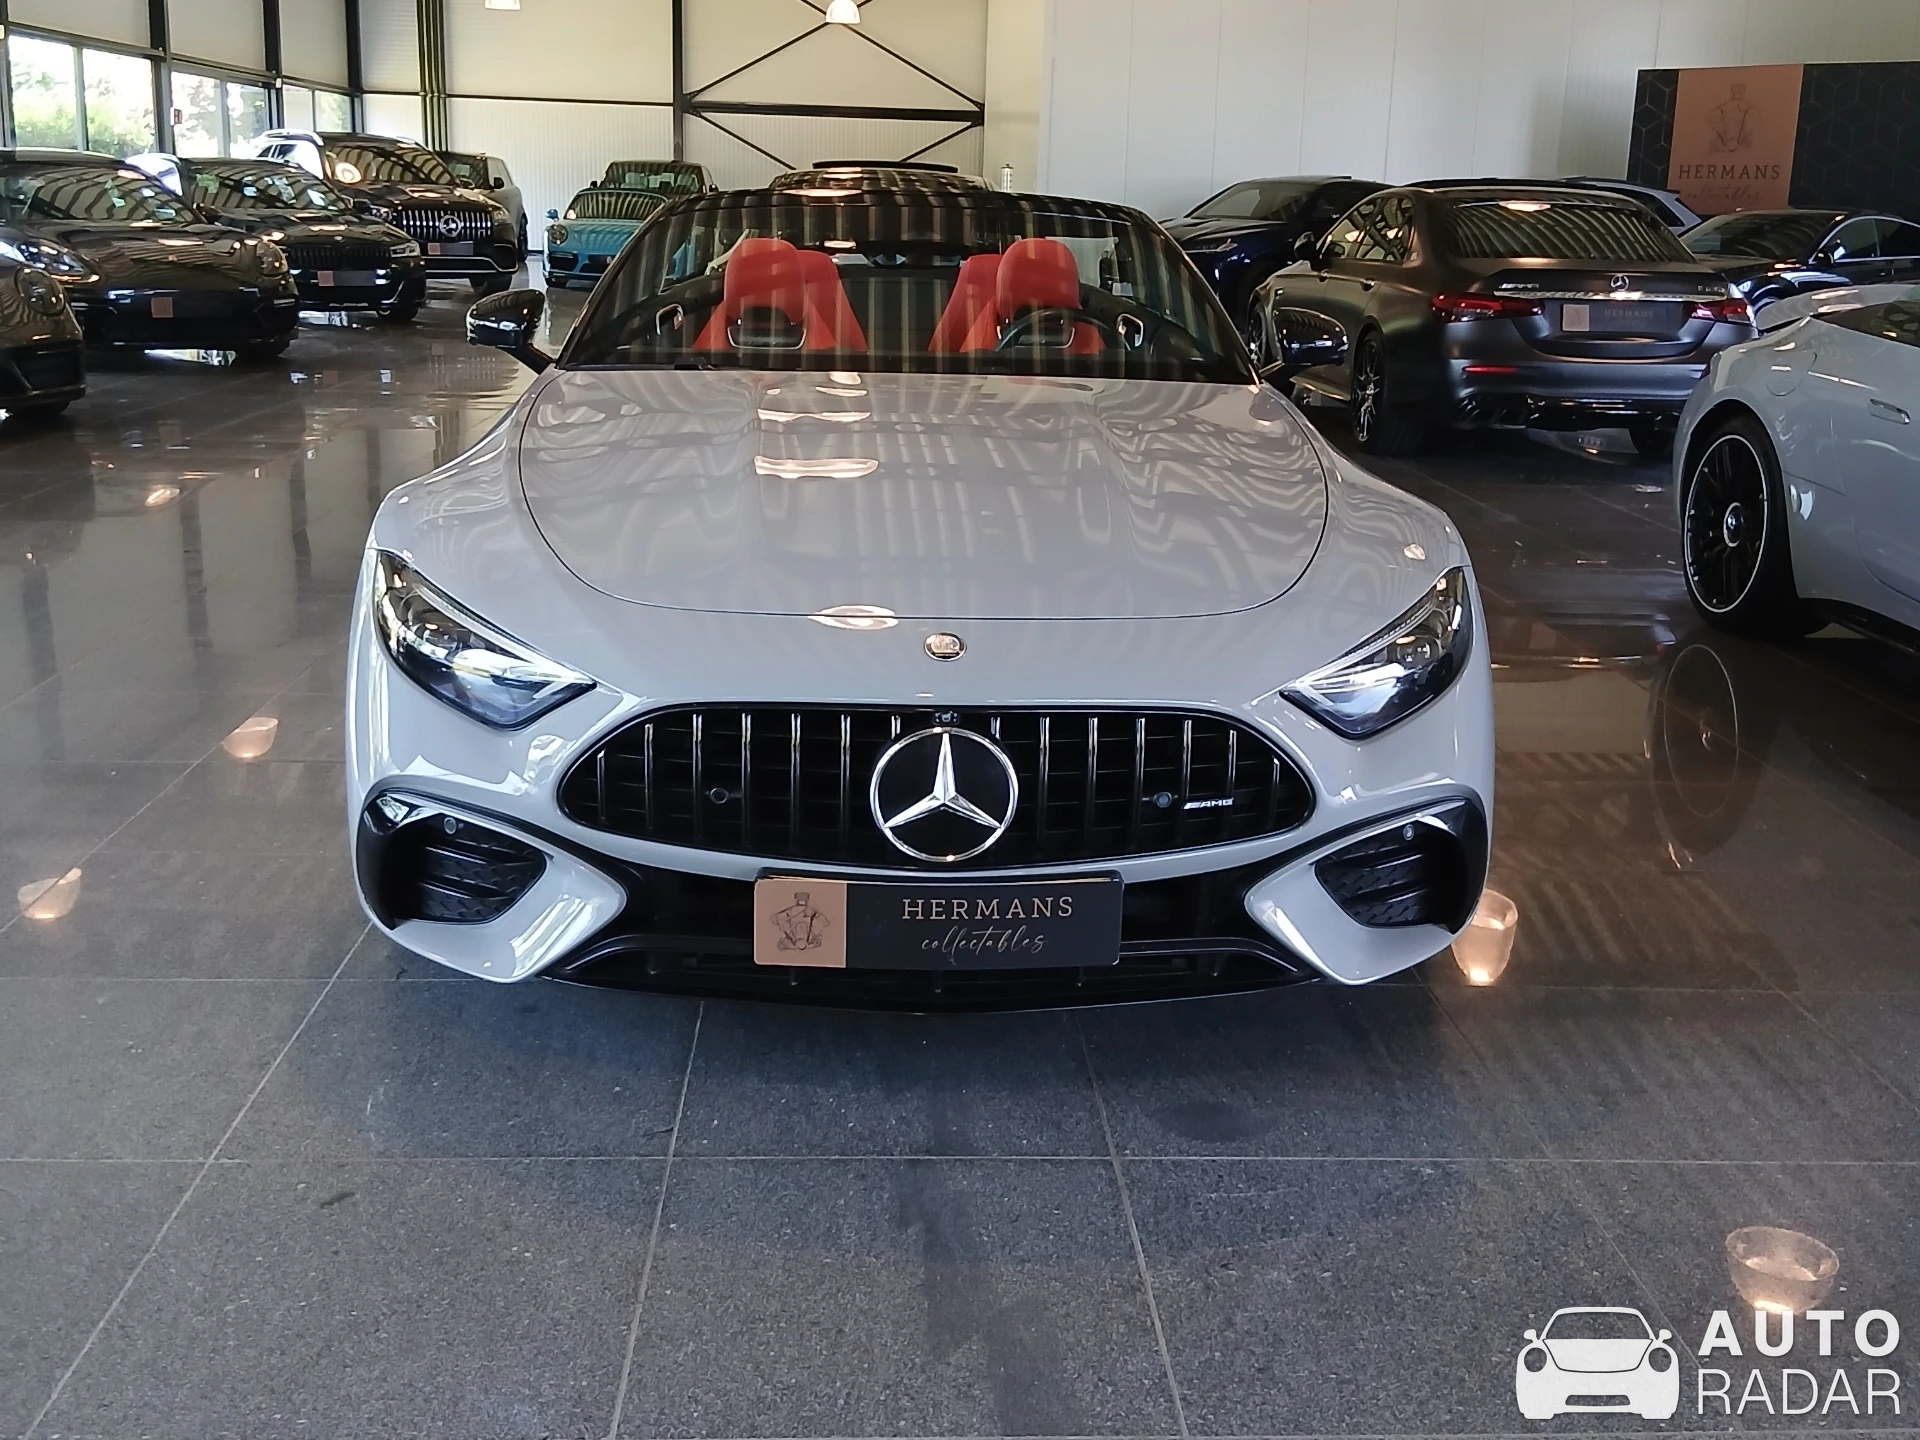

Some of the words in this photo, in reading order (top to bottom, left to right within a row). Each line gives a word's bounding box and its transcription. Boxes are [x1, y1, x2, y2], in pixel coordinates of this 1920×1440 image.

[1678, 164, 1781, 180] HERMANS
[902, 896, 1073, 920] HERMANS
[921, 924, 1050, 956] collectables
